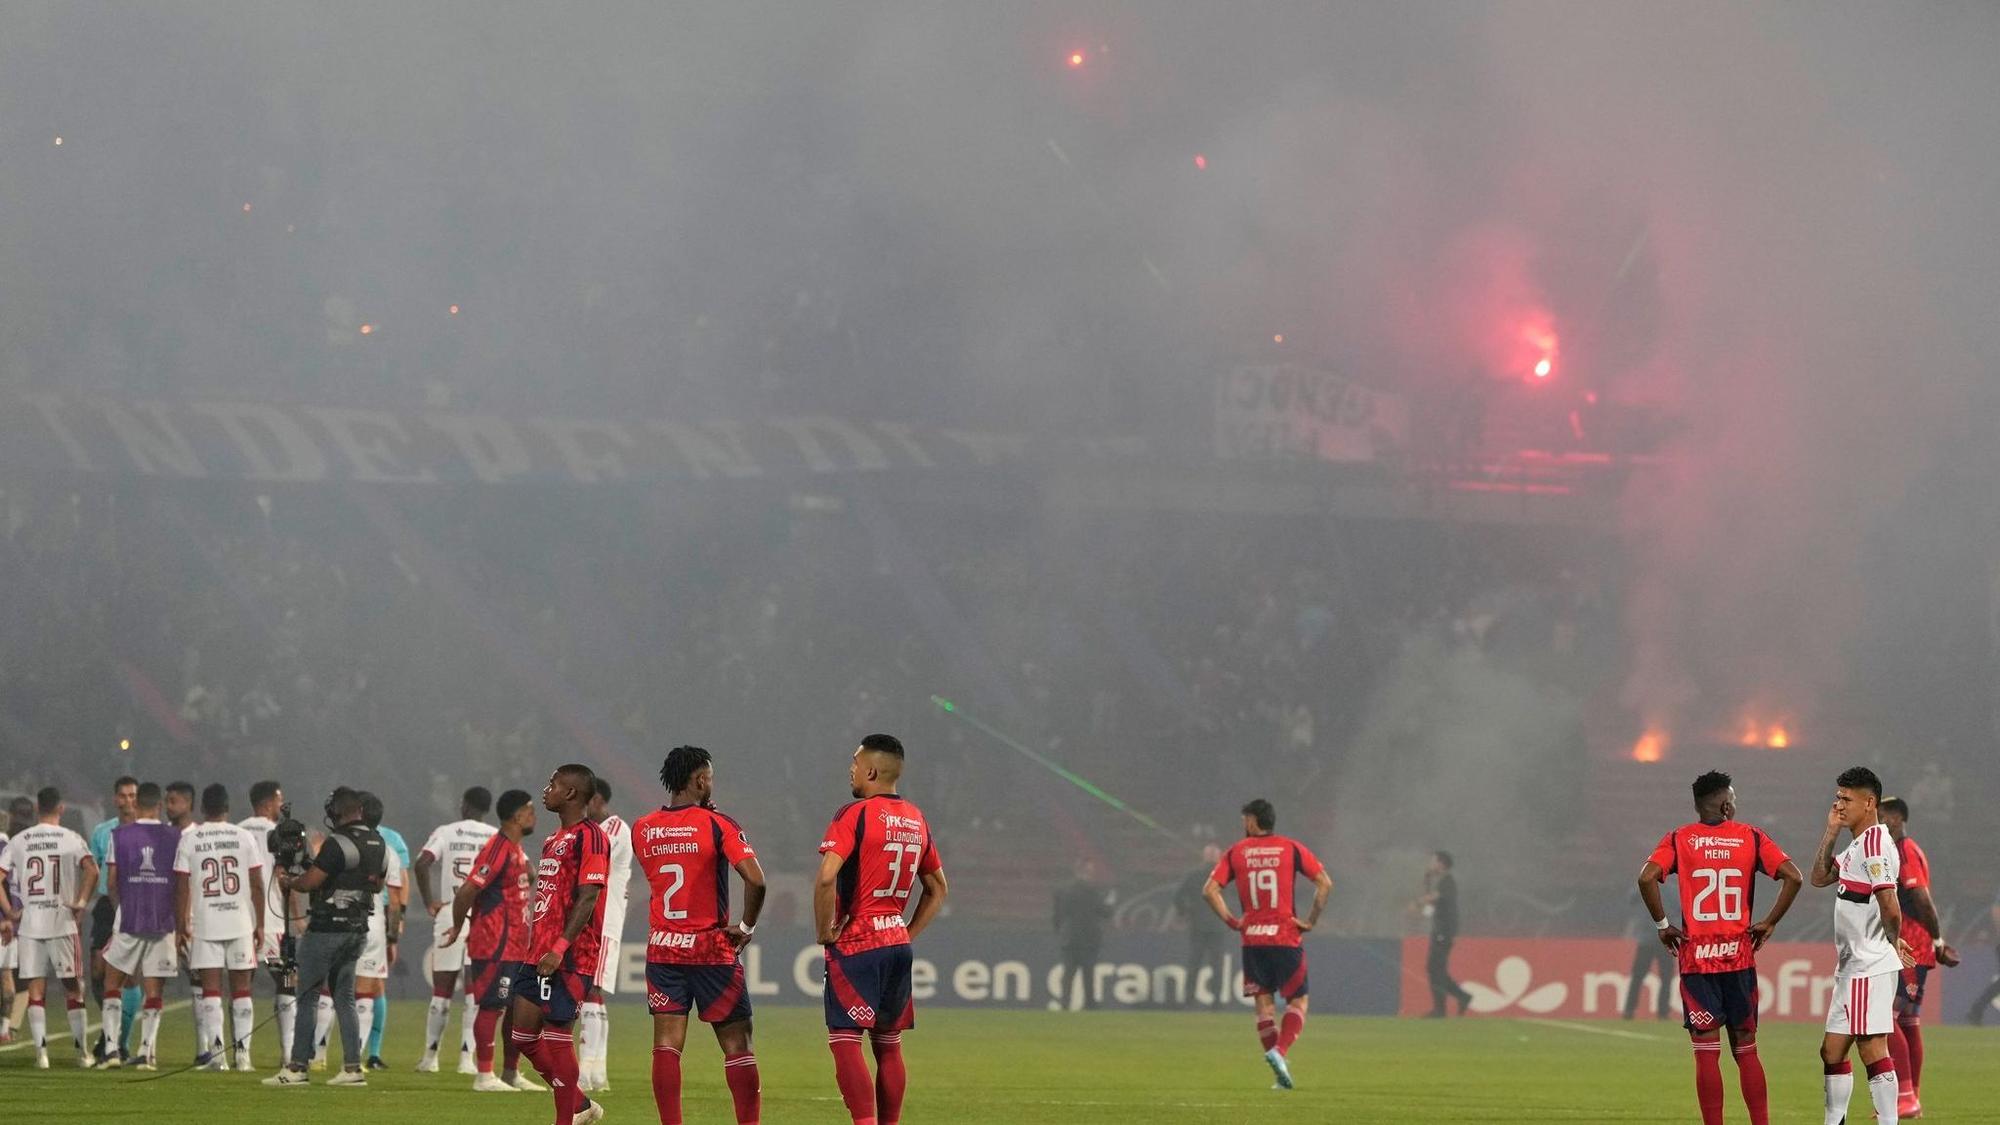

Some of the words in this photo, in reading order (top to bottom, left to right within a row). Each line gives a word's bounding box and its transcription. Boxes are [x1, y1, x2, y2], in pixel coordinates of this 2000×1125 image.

[646, 826, 666, 843] JFK
[1694, 836, 1714, 850] JFK
[1246, 857, 1280, 868] POLACO
[1704, 849, 1730, 860] MENA
[27, 855, 60, 896] 21
[201, 855, 241, 899] 26
[873, 842, 922, 898] 33
[659, 863, 688, 920] 2
[1248, 869, 1278, 910] 19
[1691, 868, 1743, 921] 26
[650, 931, 697, 948] MAPEI
[1245, 924, 1280, 936] MAPEI
[1695, 941, 1740, 959] MAPEI
[953, 960, 1031, 1001] en
